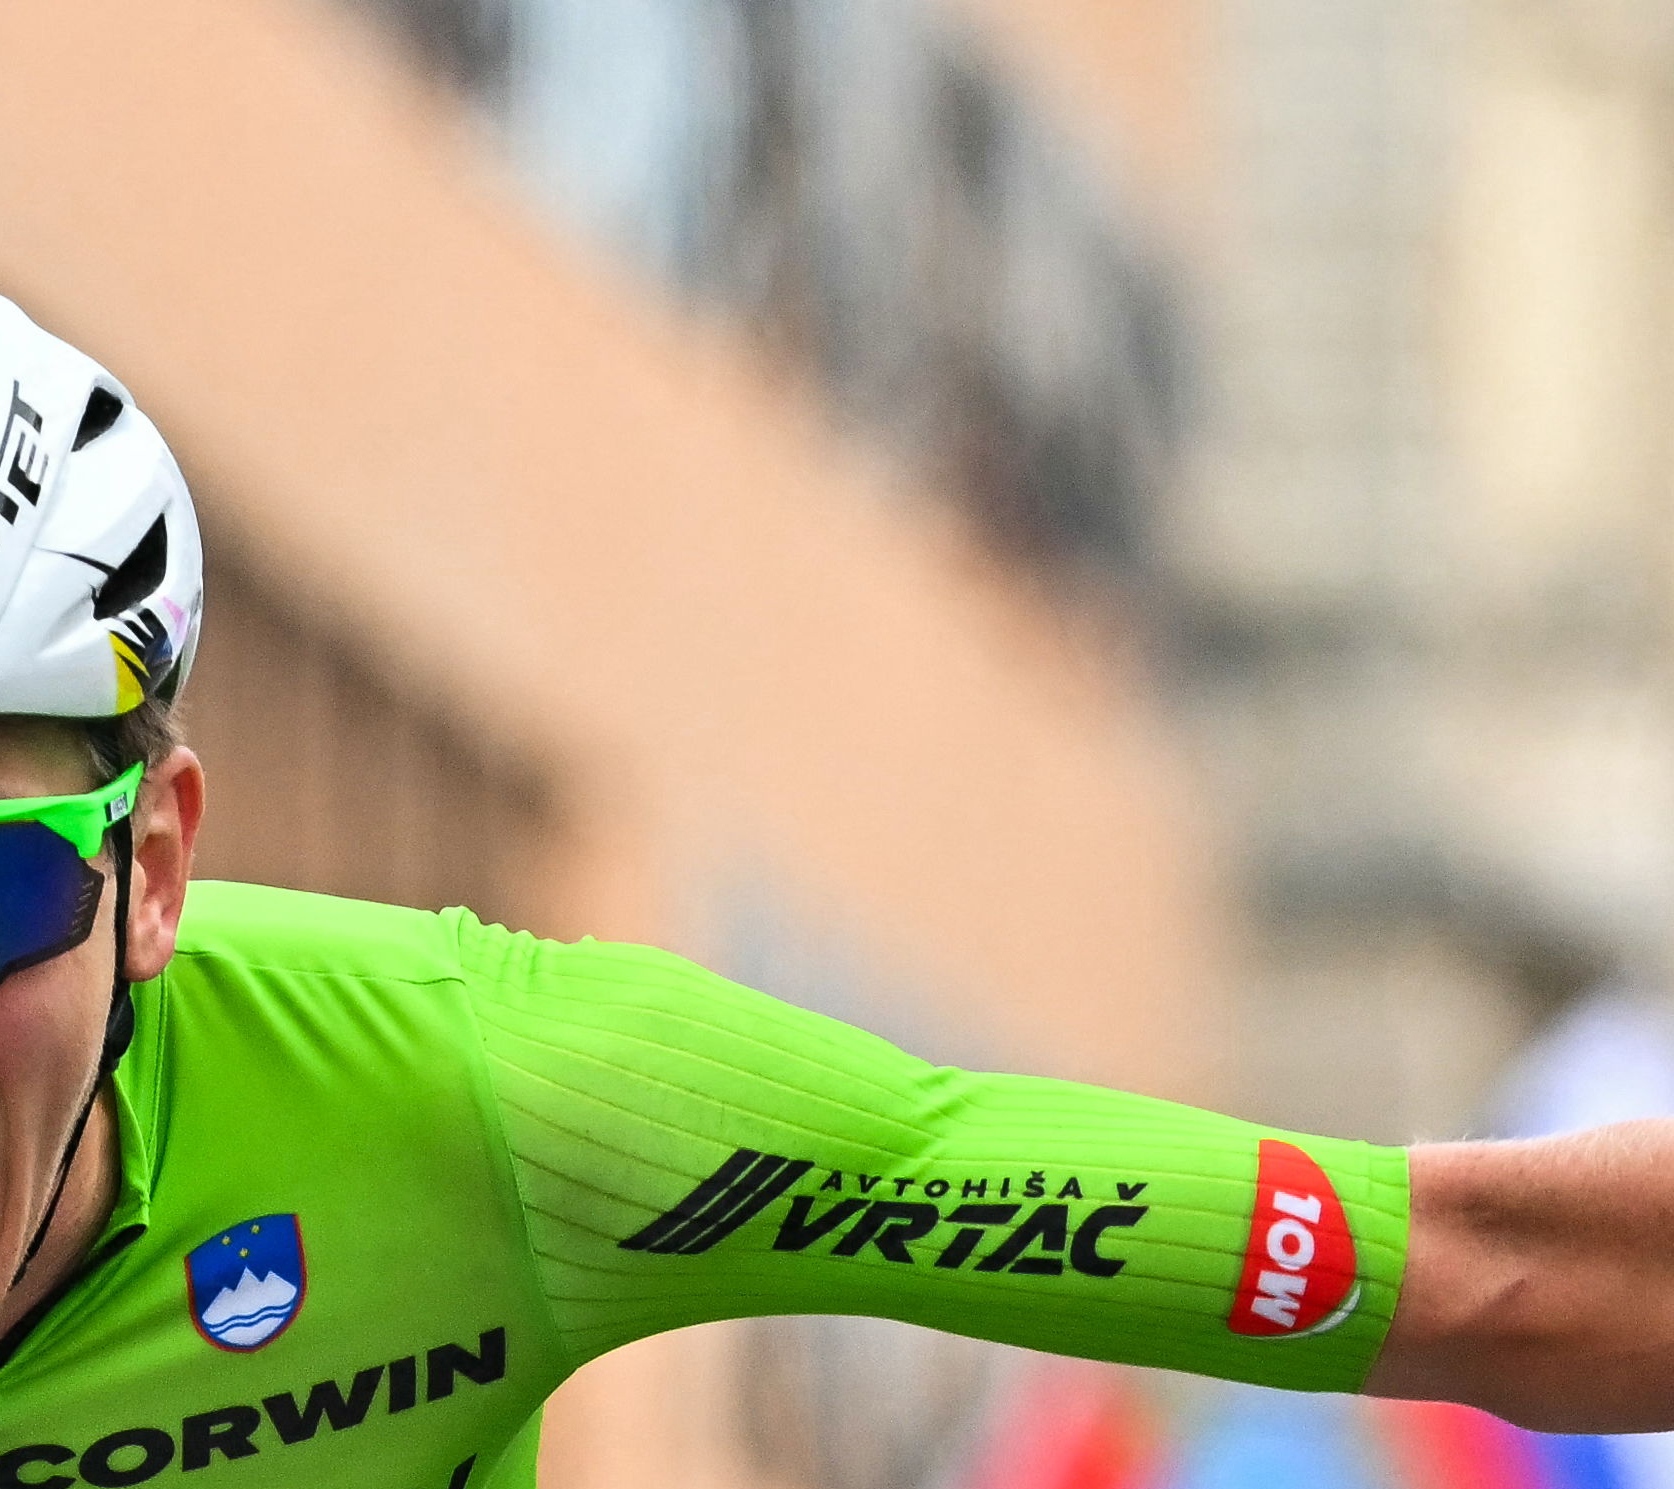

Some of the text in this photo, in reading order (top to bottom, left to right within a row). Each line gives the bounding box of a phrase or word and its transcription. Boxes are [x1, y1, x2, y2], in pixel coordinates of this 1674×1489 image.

[772, 1183, 1149, 1277] VRTAČ
[820, 1171, 1083, 1199] AVTOHIŠA
[1251, 1191, 1322, 1328] MOL
